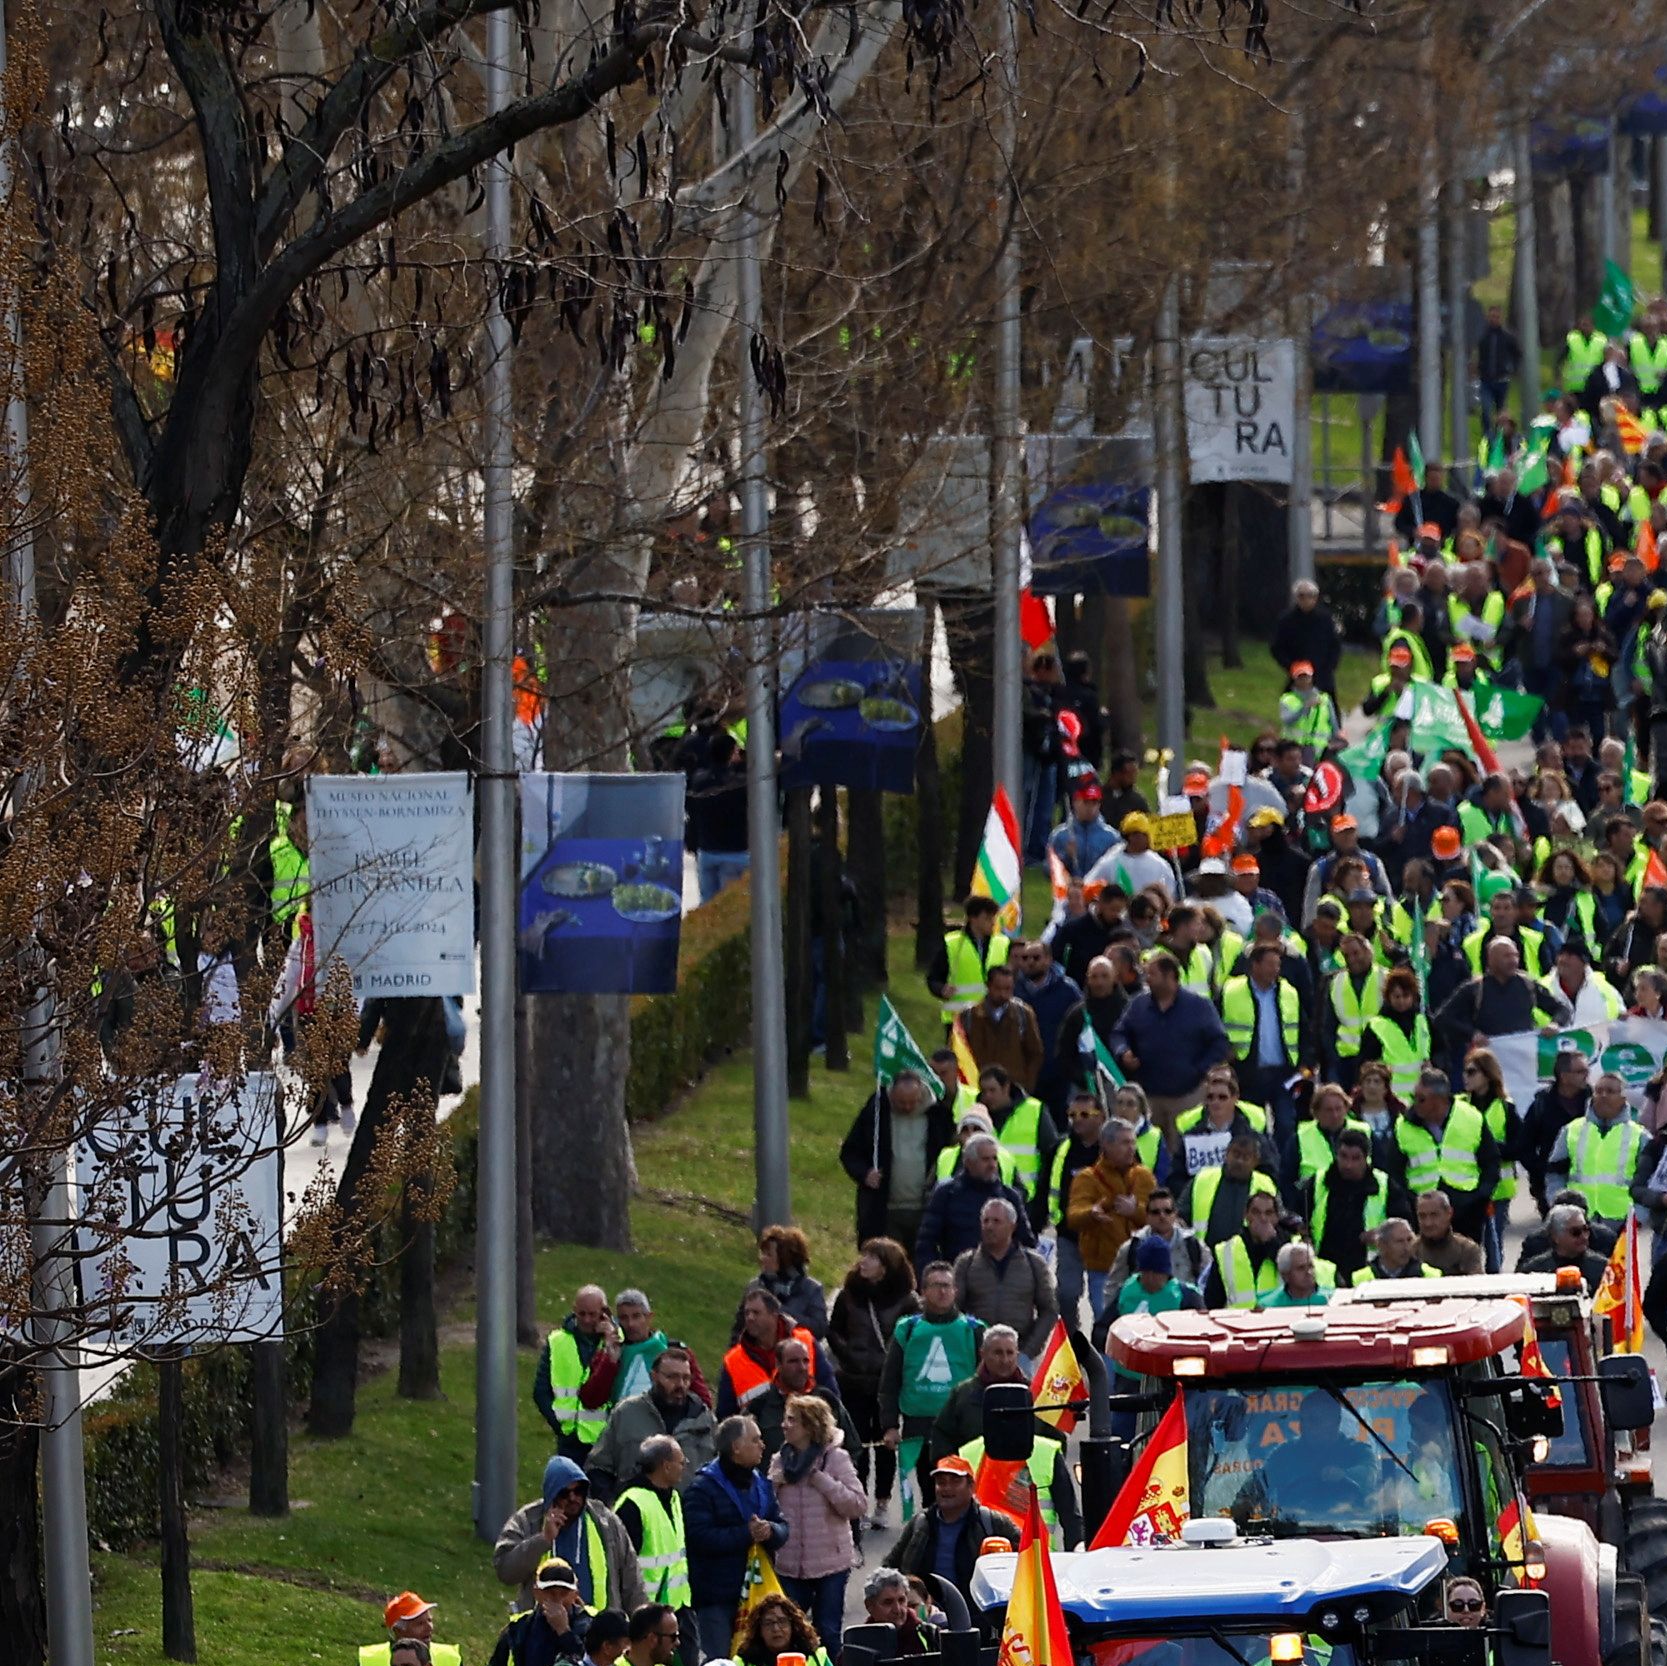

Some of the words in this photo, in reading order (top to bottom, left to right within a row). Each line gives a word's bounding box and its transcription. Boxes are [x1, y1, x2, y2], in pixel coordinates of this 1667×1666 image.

[1204, 384, 1260, 417] TU
[1236, 422, 1287, 457] RA
[371, 974, 431, 987] MADRID
